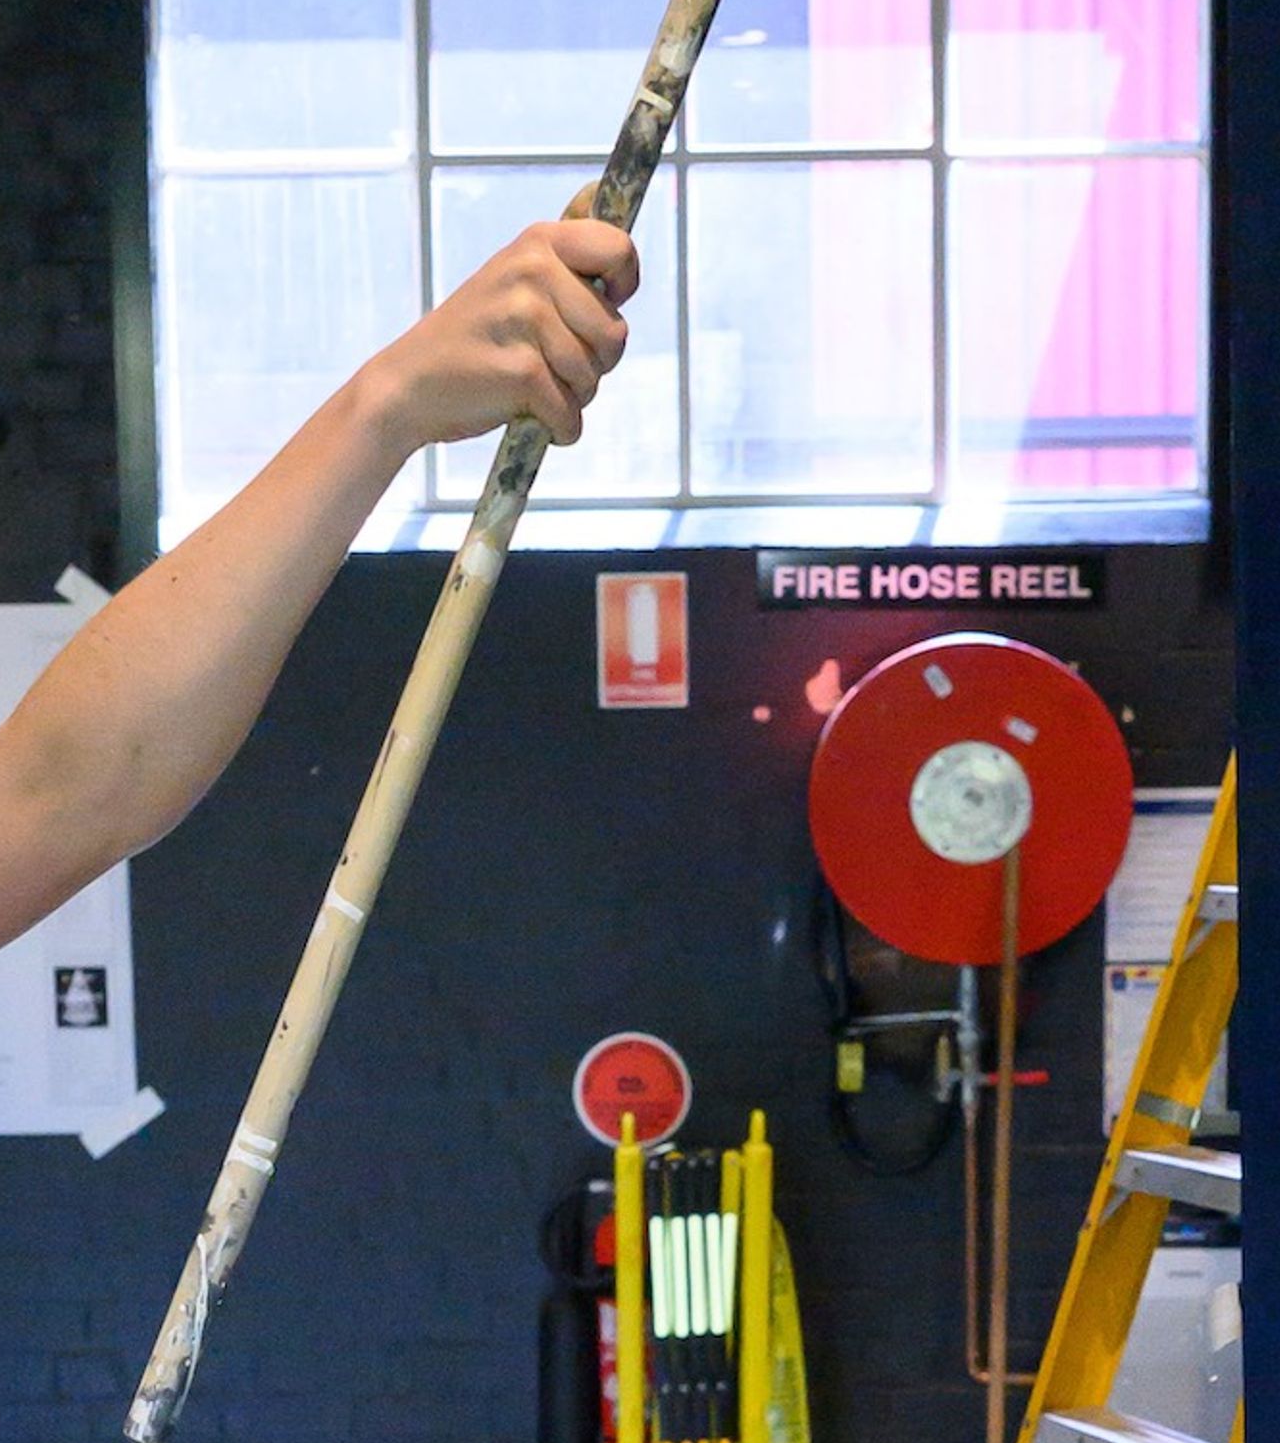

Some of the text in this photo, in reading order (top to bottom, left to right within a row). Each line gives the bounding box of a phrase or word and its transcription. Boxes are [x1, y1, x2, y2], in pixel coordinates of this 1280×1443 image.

[773, 564, 1092, 599] FIRE HOSE REEL
